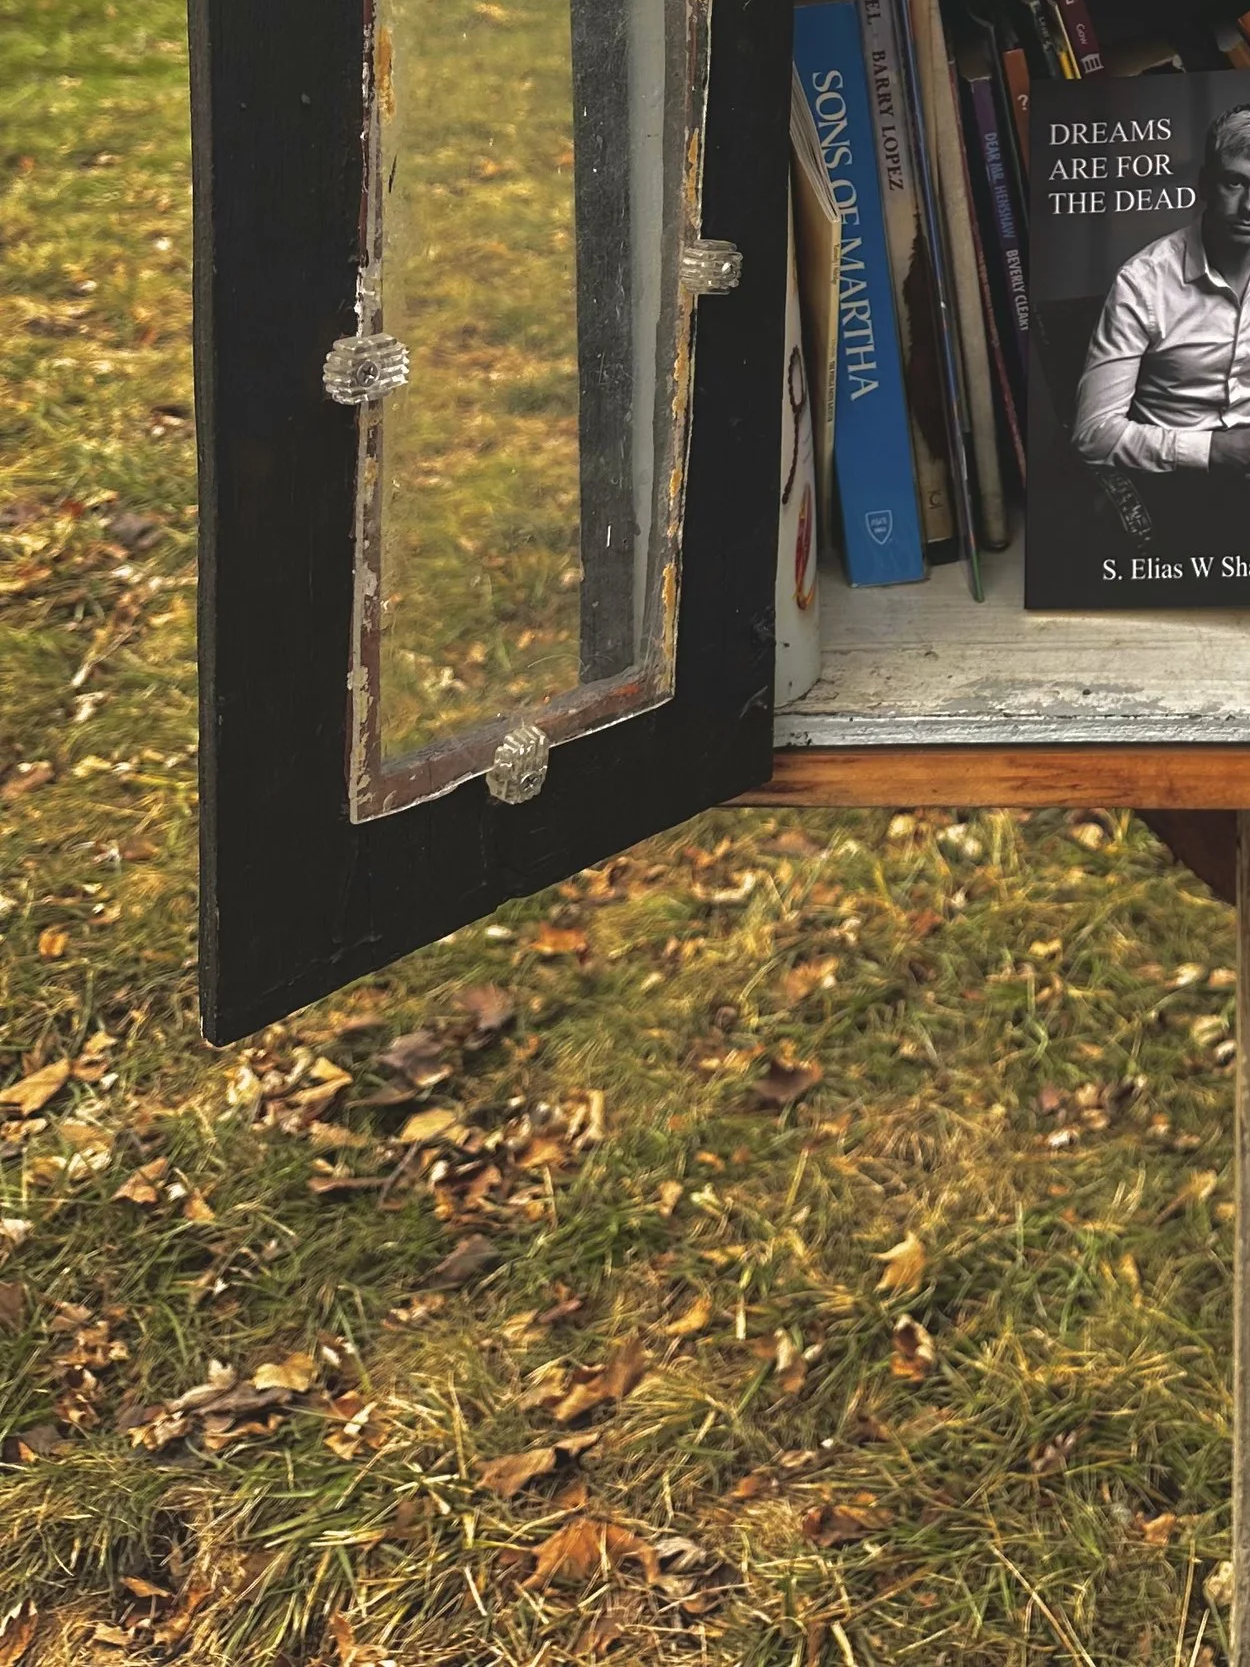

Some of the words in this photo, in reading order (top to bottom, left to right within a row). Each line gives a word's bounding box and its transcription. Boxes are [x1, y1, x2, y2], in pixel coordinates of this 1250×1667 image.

[870, 49, 894, 117] BARRY
[811, 68, 853, 168] SONS
[1048, 118, 1172, 145] DREAMS
[880, 124, 904, 194] LOPEZ
[1048, 156, 1109, 181] ARE
[1115, 153, 1174, 178] FOR
[831, 177, 860, 226] OF
[983, 131, 999, 161] DEAR
[992, 184, 1016, 239] HENSHAW
[1004, 247, 1026, 296] BEVERLY
[1047, 190, 1107, 214] THE
[1113, 185, 1196, 212] DEAD
[838, 236, 881, 402] MARTHA
[1101, 557, 1123, 580] S.
[1130, 556, 1184, 580] Elias
[1189, 555, 1215, 578] W
